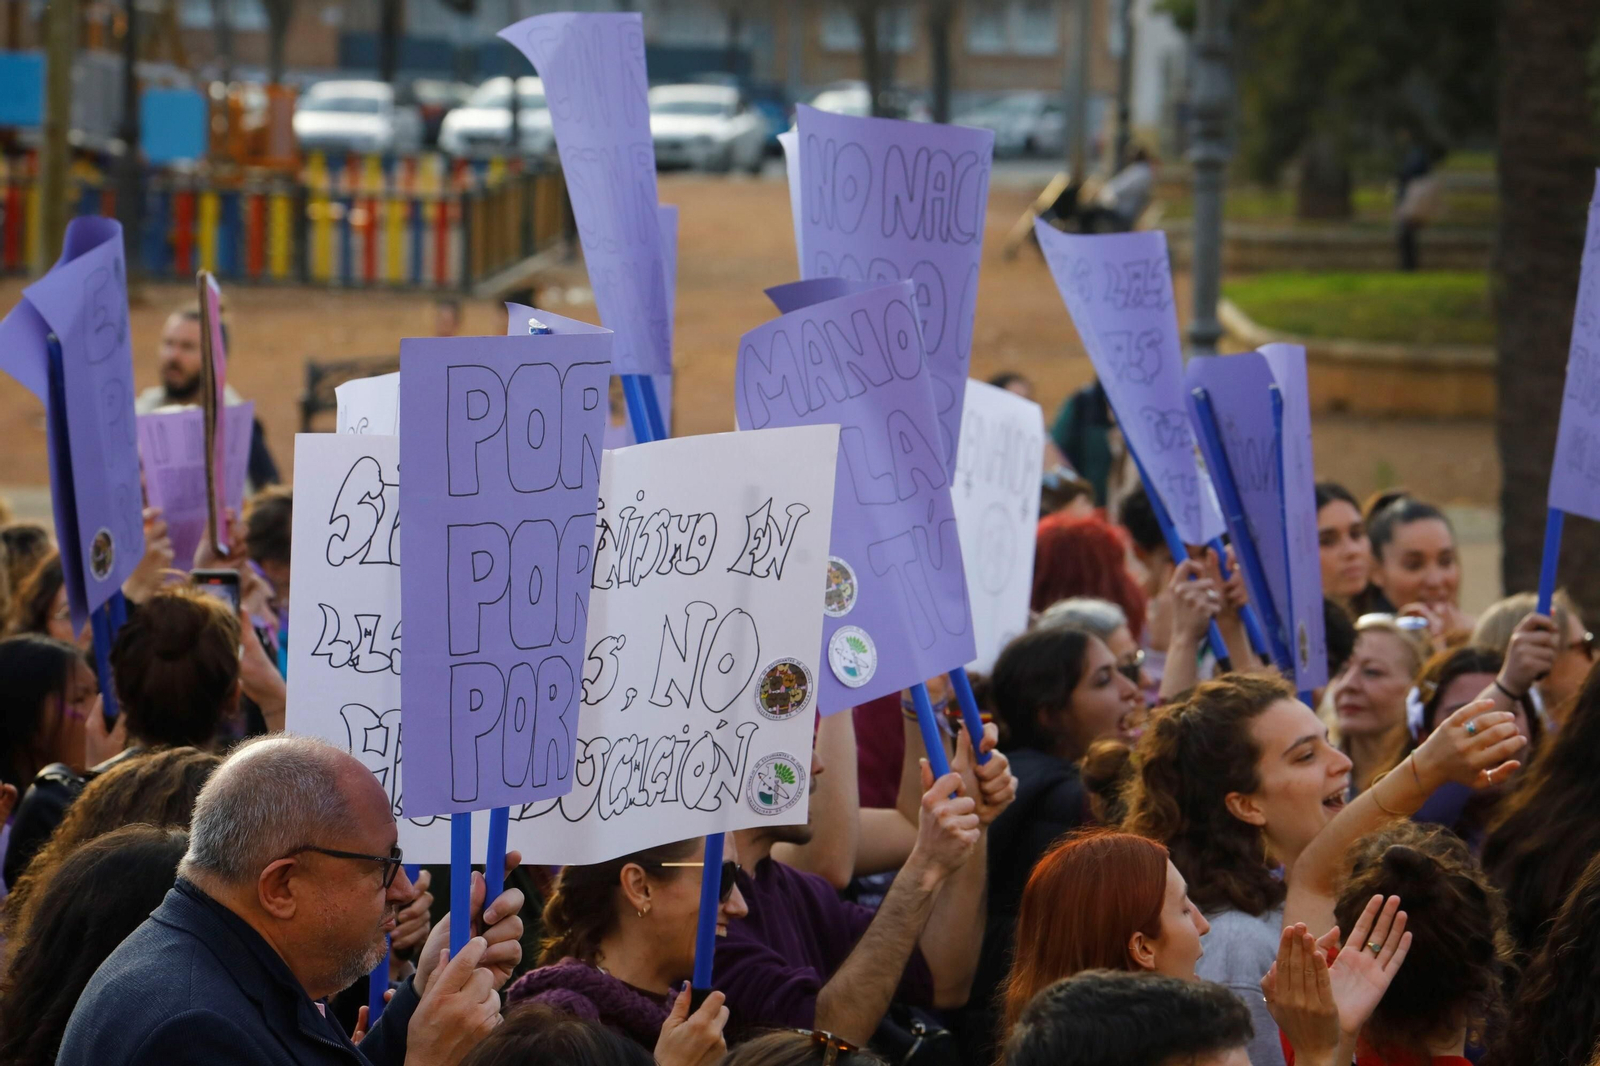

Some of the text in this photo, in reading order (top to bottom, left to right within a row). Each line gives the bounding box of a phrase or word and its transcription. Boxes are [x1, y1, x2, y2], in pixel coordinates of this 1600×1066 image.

[807, 133, 873, 235] NO
[743, 296, 925, 430] MANO
[447, 361, 612, 497] POR
[840, 410, 947, 506] LA
[447, 513, 598, 656] POR
[590, 489, 718, 590] NISMO
[727, 496, 811, 581] EN
[867, 498, 967, 651] TÚ
[648, 600, 761, 714] NO
[449, 655, 575, 803] POR
[508, 719, 760, 823] UCACIÓN
